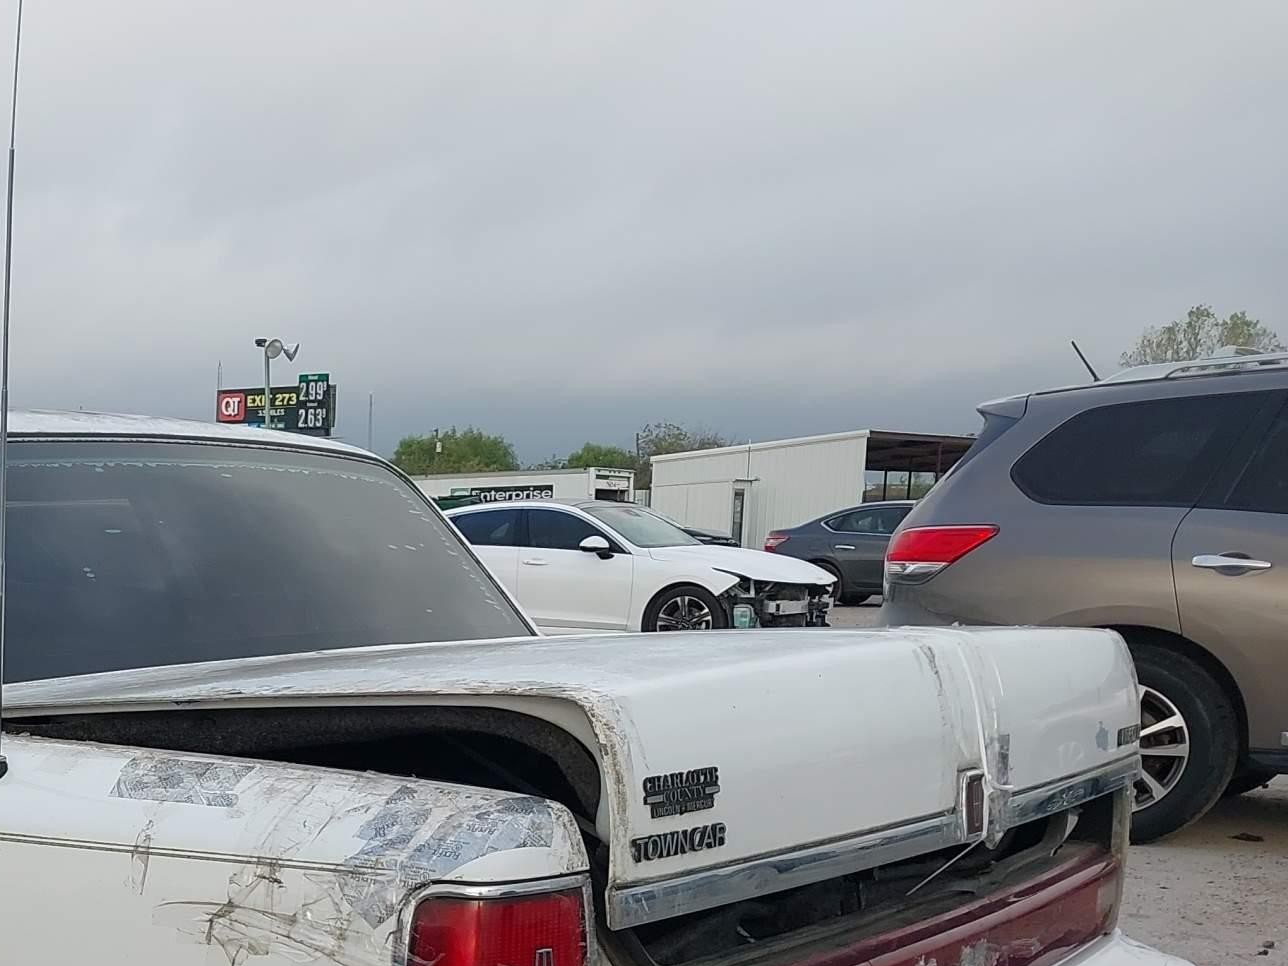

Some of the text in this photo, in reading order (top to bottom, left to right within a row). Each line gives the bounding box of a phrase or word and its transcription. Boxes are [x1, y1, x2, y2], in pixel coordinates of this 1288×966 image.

[221, 397, 240, 416] QT
[247, 392, 297, 407] EXI 273
[644, 767, 719, 794] CHARLOTTE
[663, 786, 706, 803] COUNTY
